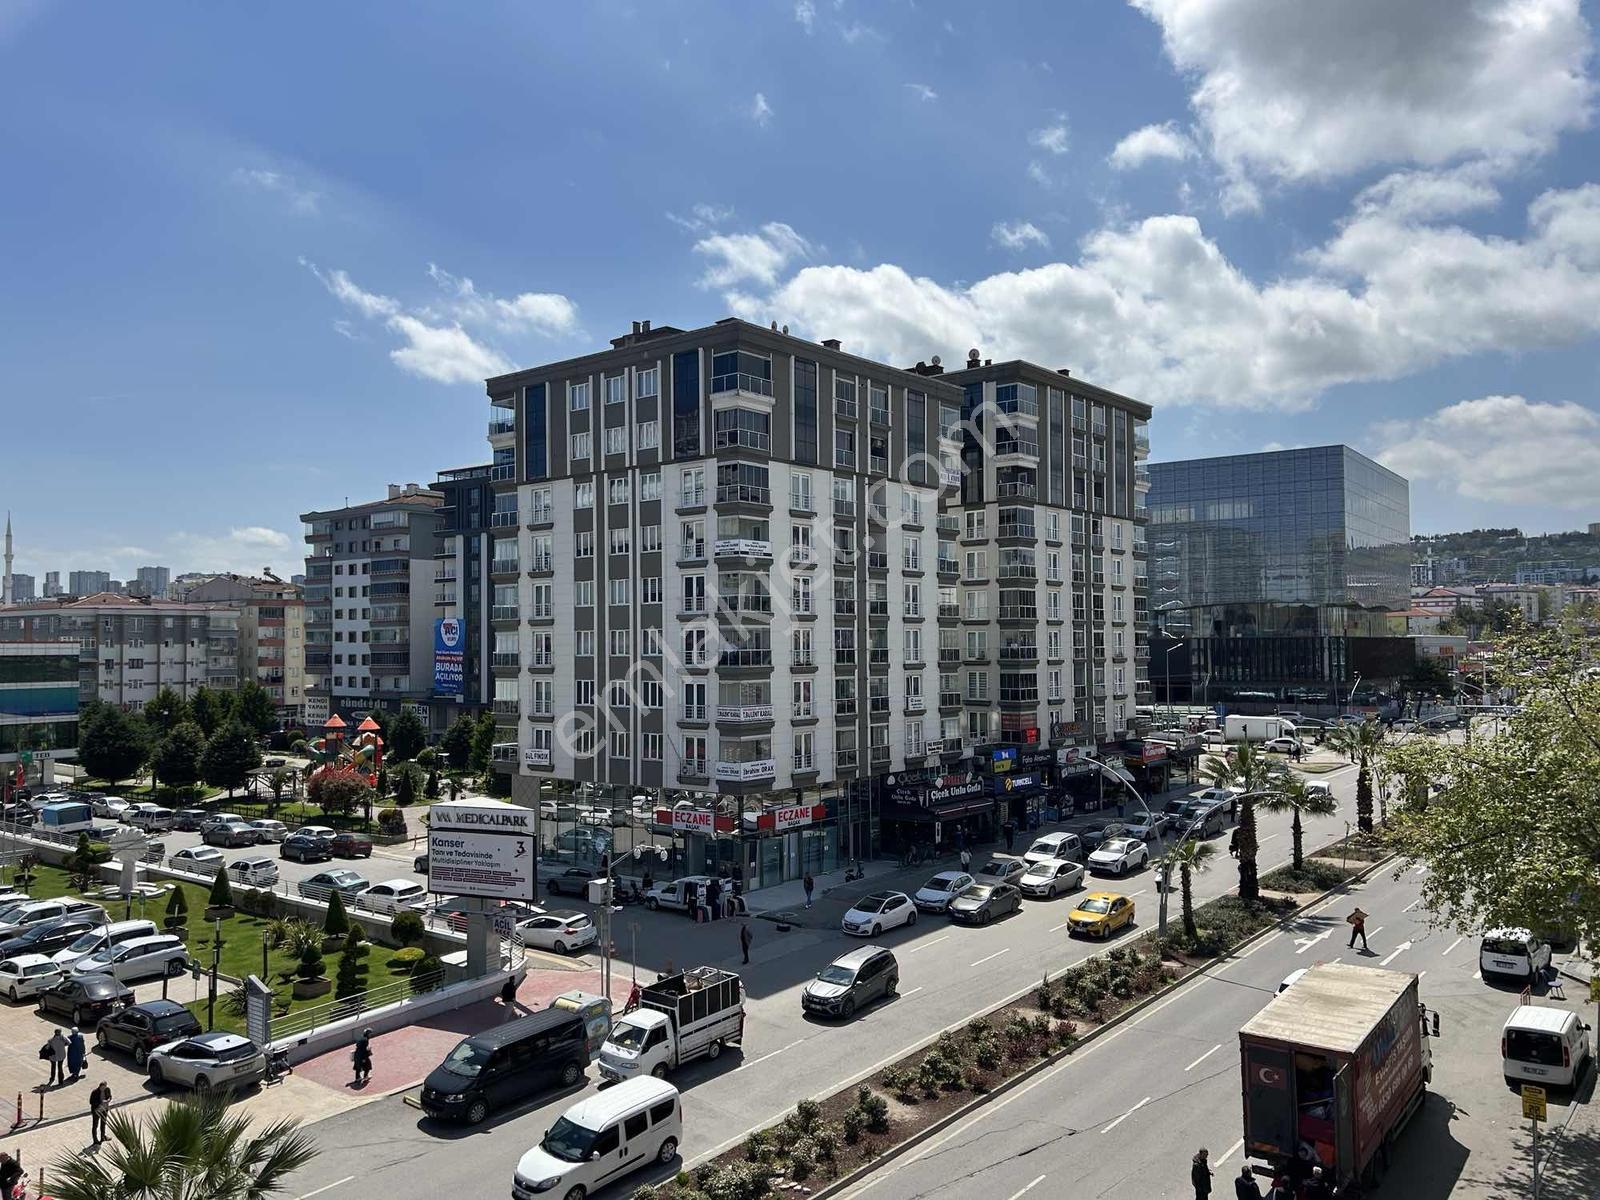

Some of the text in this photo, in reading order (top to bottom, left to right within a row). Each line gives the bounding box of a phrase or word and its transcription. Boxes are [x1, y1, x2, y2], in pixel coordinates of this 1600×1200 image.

[435, 662, 463, 672] BURADA
[435, 672, 463, 682] AÇILIYOR
[1012, 776, 1033, 787] TURKCELL
[931, 788, 949, 801] Çiçek
[950, 786, 966, 797] Unlu
[455, 812, 528, 827] MEDICALPARK
[675, 811, 711, 826] ECZANE
[778, 806, 810, 822] ECZANE
[432, 837, 465, 848] Kanser
[432, 848, 446, 856] Tanı
[455, 850, 493, 860] Tedavisinde
